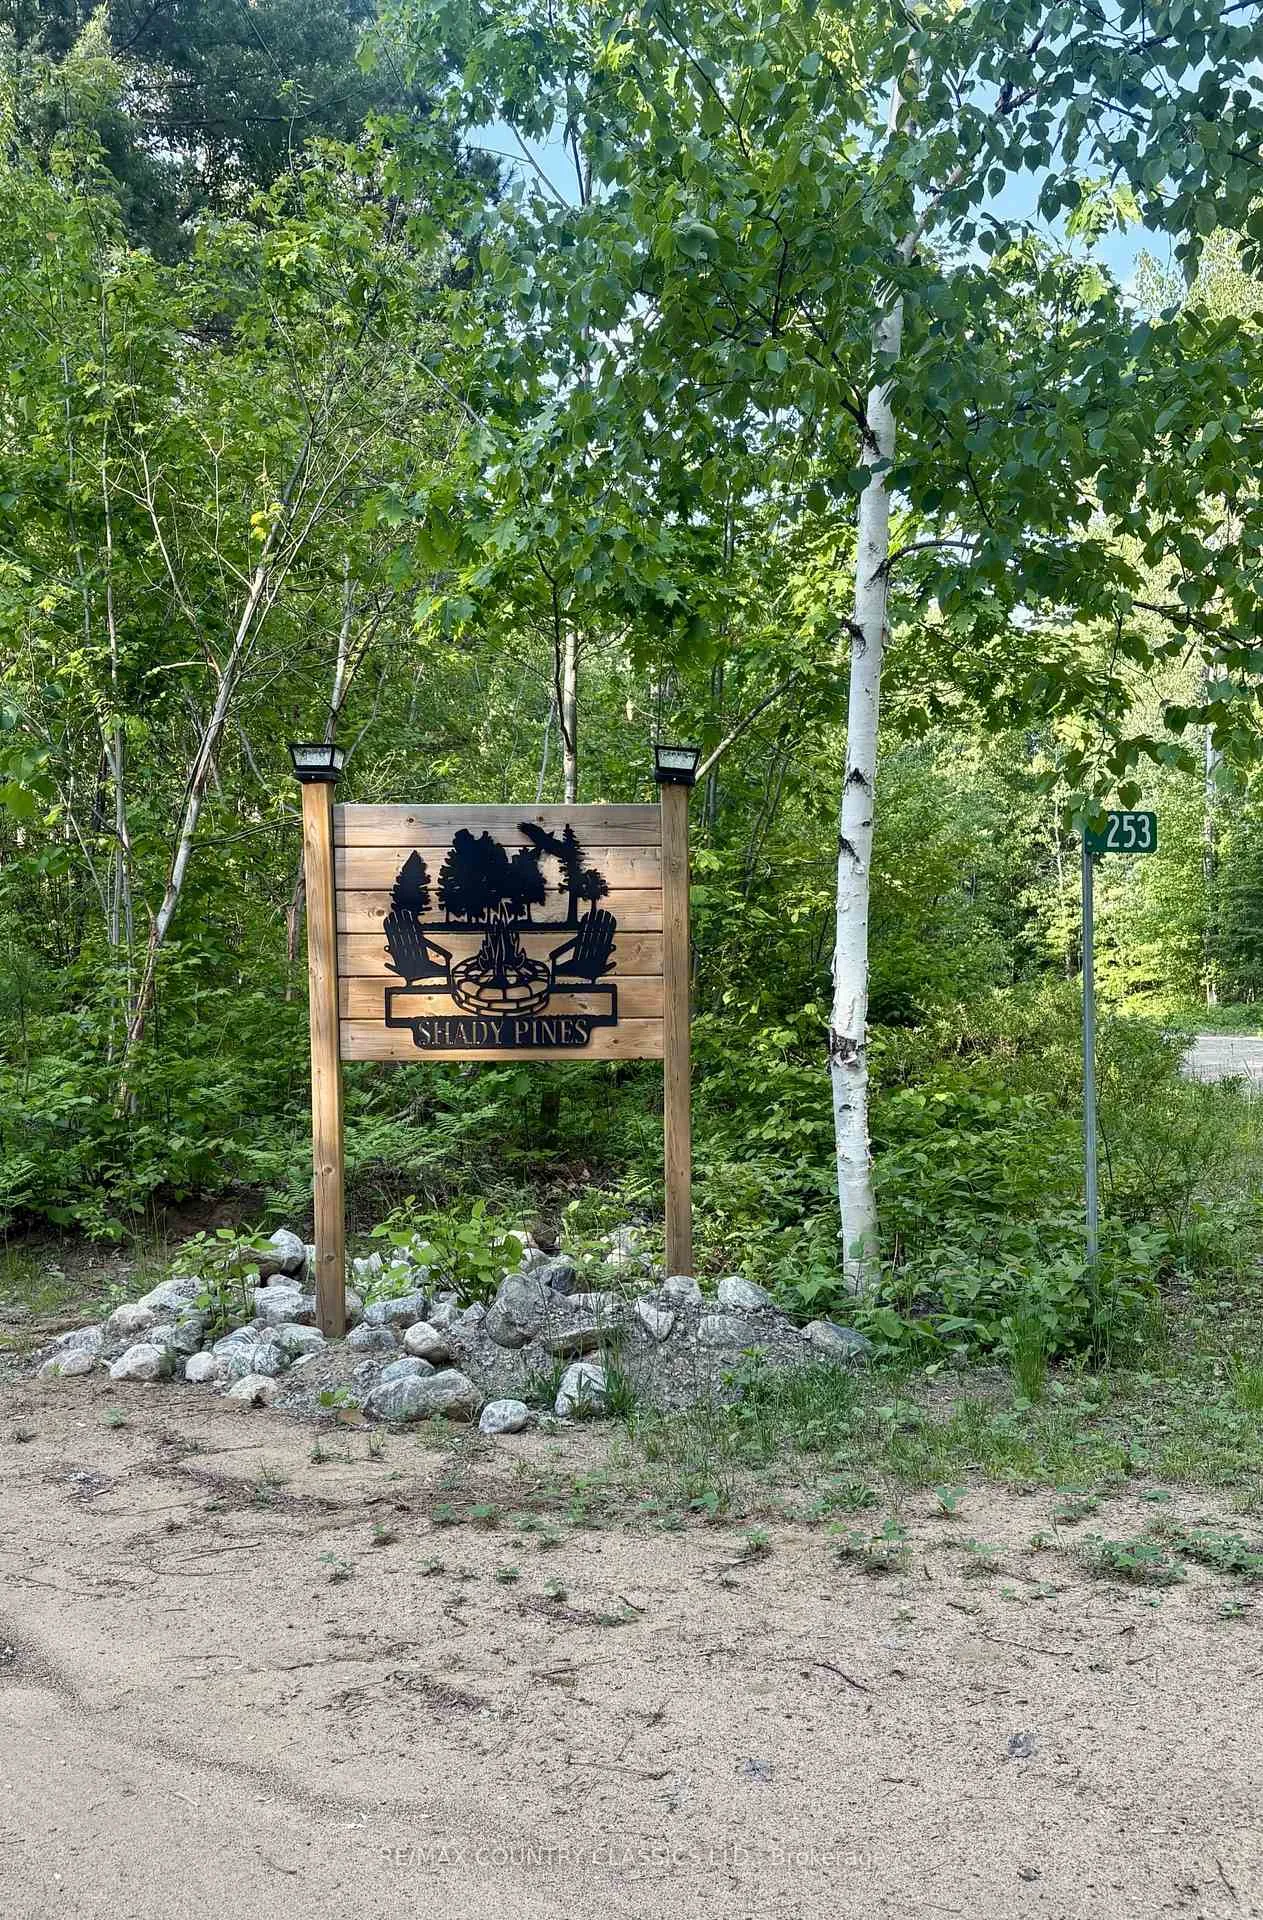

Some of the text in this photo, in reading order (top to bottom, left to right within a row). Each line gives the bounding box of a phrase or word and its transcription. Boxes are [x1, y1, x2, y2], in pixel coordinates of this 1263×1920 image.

[1106, 814, 1151, 848] 253
[417, 1018, 588, 1045] SHADY PINES
